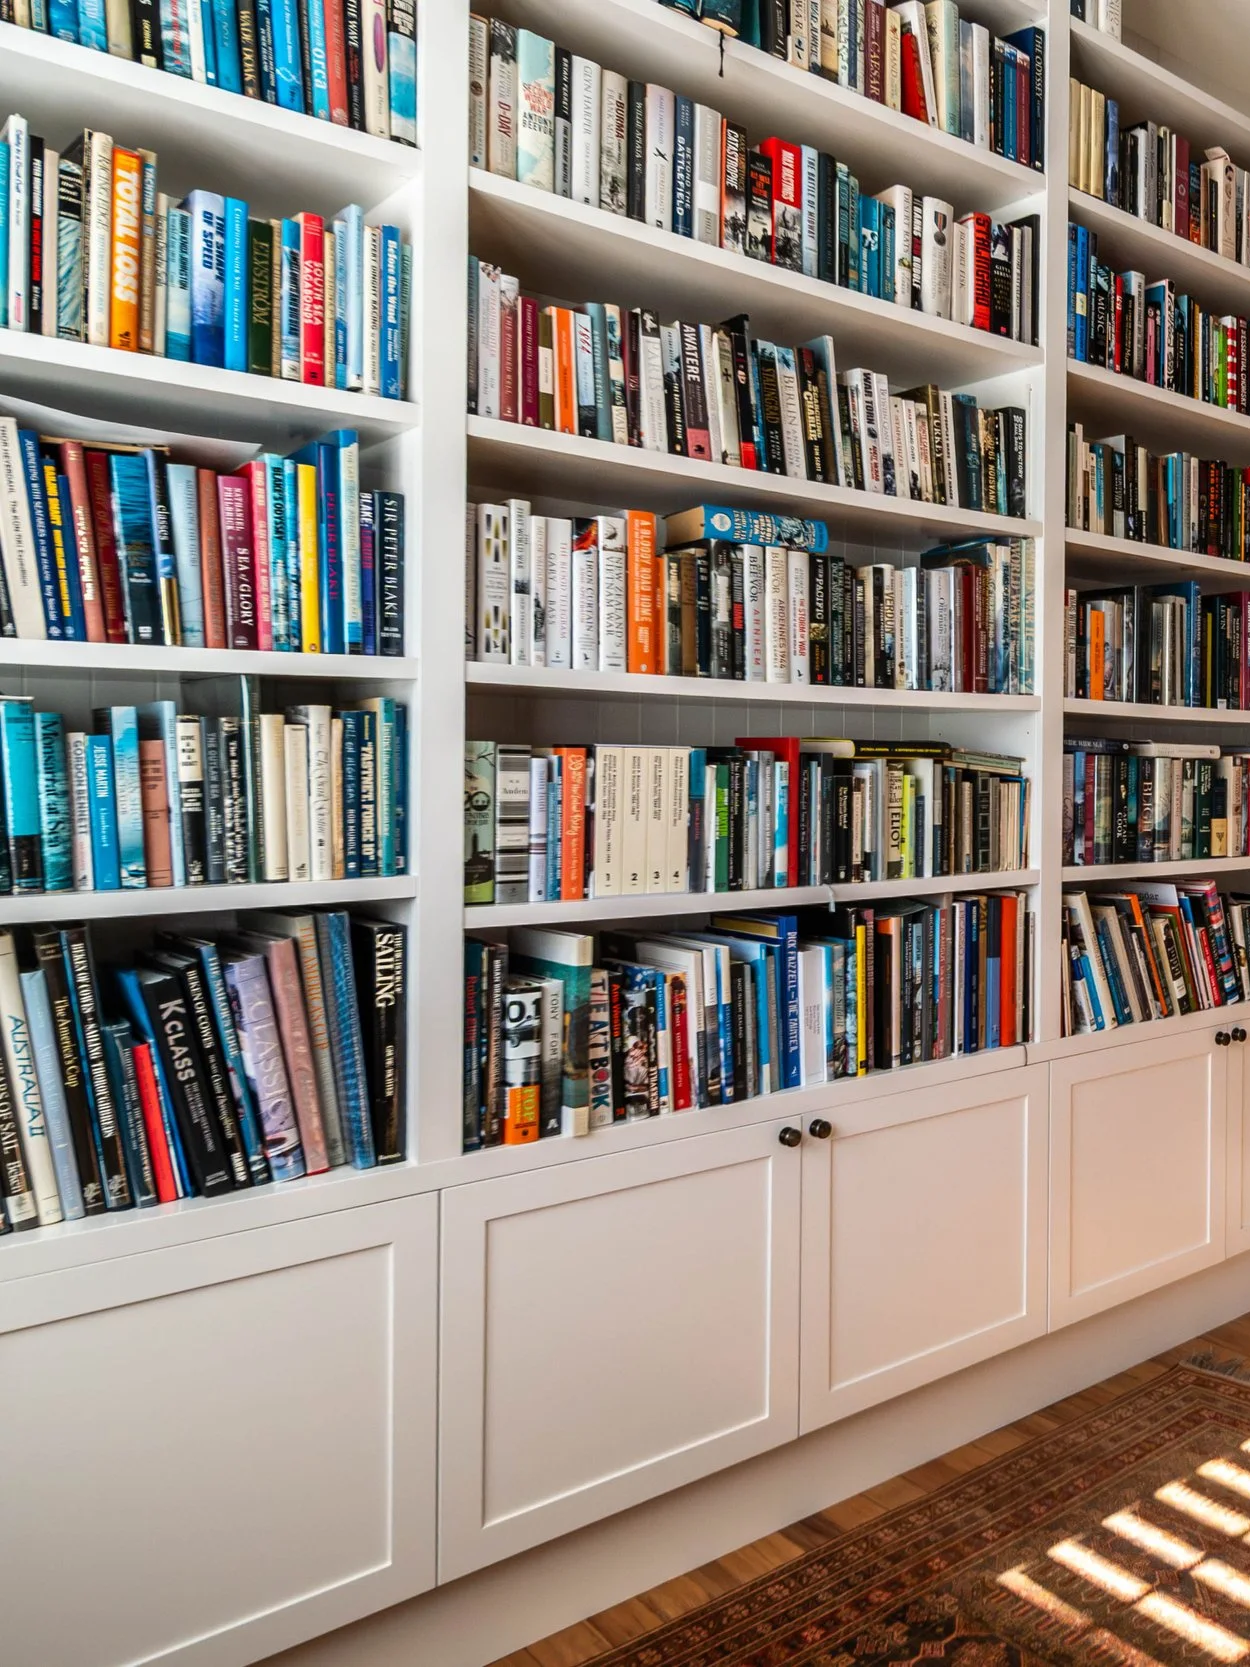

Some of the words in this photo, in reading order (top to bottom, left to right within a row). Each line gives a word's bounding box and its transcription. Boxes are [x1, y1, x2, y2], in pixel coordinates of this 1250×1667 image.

[240, 10, 252, 44] WADE
[348, 20, 359, 48] WAVE
[243, 47, 256, 83] DOAK
[312, 47, 328, 89] orca
[584, 66, 592, 92] GLYN
[870, 41, 880, 96] CAESAR
[498, 100, 512, 138] D-DAY
[583, 95, 592, 135] HARPER
[616, 100, 625, 140] BURMA
[677, 135, 685, 216] BATTLEFIELD
[726, 129, 738, 190] CATASTROPHE
[781, 150, 794, 167] MAX
[781, 167, 794, 202] HASTINGS
[115, 167, 139, 240] TOTAL
[202, 210, 212, 227] OF
[809, 200, 815, 208] OF
[913, 206, 921, 237] HANNS
[202, 230, 212, 270] SPEED
[387, 240, 397, 275] Before
[976, 217, 989, 307] STALINGRAD
[115, 242, 138, 305] LOSS
[313, 262, 323, 300] SOUTH
[388, 275, 397, 294] the
[913, 256, 921, 290] RUDOLF
[304, 260, 313, 324] VAGABONDS
[387, 296, 397, 323] Wind
[313, 304, 323, 326] SEA
[1097, 295, 1105, 333] MUSIC
[682, 324, 699, 382] AWATERE
[762, 367, 779, 424] STALINGRAD
[783, 374, 797, 426] BERLIN
[863, 372, 872, 397] WAR
[803, 391, 817, 441] CHARLIE
[812, 386, 822, 438] SEARCHING
[865, 401, 874, 425] TORN
[933, 413, 942, 458] TURKEY
[256, 471, 264, 484] BIG
[272, 467, 282, 501] BLAKE'S
[46, 498, 61, 526] SMART
[224, 487, 234, 530] PHILBRICK
[236, 488, 246, 531] NATHANIEL
[257, 490, 265, 506] RED
[384, 499, 398, 522] SIR
[273, 503, 284, 541] ODYSSEY
[326, 492, 337, 543] PETER
[237, 547, 250, 570] SEA
[384, 528, 398, 570] PETER
[641, 529, 651, 564] BLOODY
[328, 548, 338, 600] BLAKE
[606, 556, 615, 607] VIETNAM
[616, 558, 624, 583] NEW
[641, 568, 651, 591] ROAD
[749, 556, 758, 602] BEEVOR
[771, 552, 780, 594] BEEVOR
[239, 584, 253, 626] GLORY
[384, 576, 398, 618] BLAKE
[586, 587, 594, 631] CURTAIN
[641, 595, 651, 622] HOME
[816, 578, 824, 619] PACIFIC
[885, 592, 894, 634] VERDUN
[607, 612, 615, 635] WAR
[616, 586, 624, 648] ZEALAND'S
[778, 599, 786, 648] ARDENNES
[798, 608, 806, 633] STORM
[753, 609, 761, 666] ARNHEM
[41, 720, 59, 802] Monsarrat
[73, 740, 85, 789] GORDON
[93, 746, 108, 768] JESSE
[95, 770, 109, 798] MARTIN
[348, 784, 356, 803] SEAS
[47, 803, 60, 816] at
[76, 789, 88, 835] BENNETT
[1143, 782, 1152, 832] BLIGH
[48, 821, 65, 848] Sea
[347, 825, 356, 855] MUNDLE
[891, 813, 899, 850] ELIOT
[787, 932, 797, 948] DICK
[186, 970, 205, 1002] BEKEN
[375, 933, 395, 1008] SAILING
[787, 951, 797, 989] FRIZZELL
[54, 996, 69, 1018] The
[158, 998, 185, 1020] K
[194, 1002, 207, 1015] OF
[209, 957, 222, 977] THE
[223, 1029, 237, 1058] EDGE
[466, 976, 477, 1015] Robert
[551, 993, 559, 1020] TONY
[590, 979, 608, 1014] THE
[789, 1001, 797, 1015] THE
[57, 1016, 78, 1066] America's
[85, 1023, 104, 1059] SAILING
[164, 1020, 196, 1081] CLASS
[311, 1023, 328, 1050] CUP
[589, 1021, 609, 1052] ART
[789, 1017, 798, 1053] PAINTER
[8, 1015, 41, 1122] AUSTRALIA
[29, 1125, 44, 1137] II
[65, 1066, 80, 1087] Cup
[250, 1001, 289, 1119] CLASSIC
[591, 1059, 609, 1110] BOOK
[523, 1088, 535, 1120] POP
[1, 1121, 16, 1154] SAIL
[7, 1160, 26, 1194] Beken
